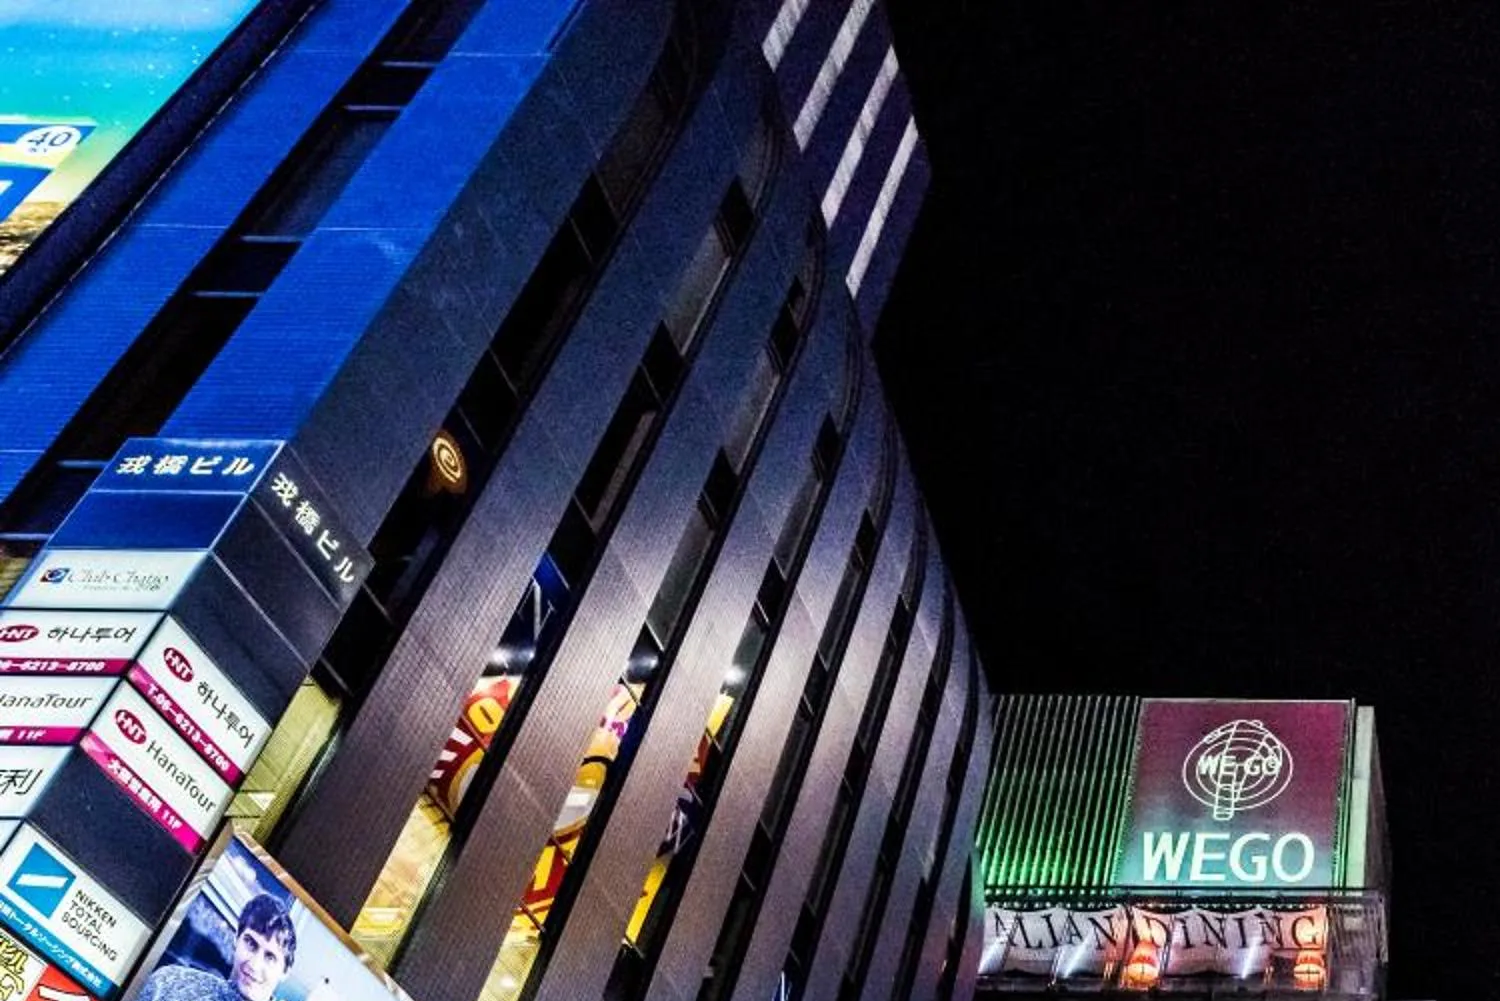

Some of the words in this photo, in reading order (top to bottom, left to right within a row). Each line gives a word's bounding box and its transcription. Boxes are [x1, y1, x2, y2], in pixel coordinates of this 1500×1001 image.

[0, 693, 93, 709] anaTour
[146, 740, 217, 814] HanaTour
[1141, 831, 1315, 882] WEGO
